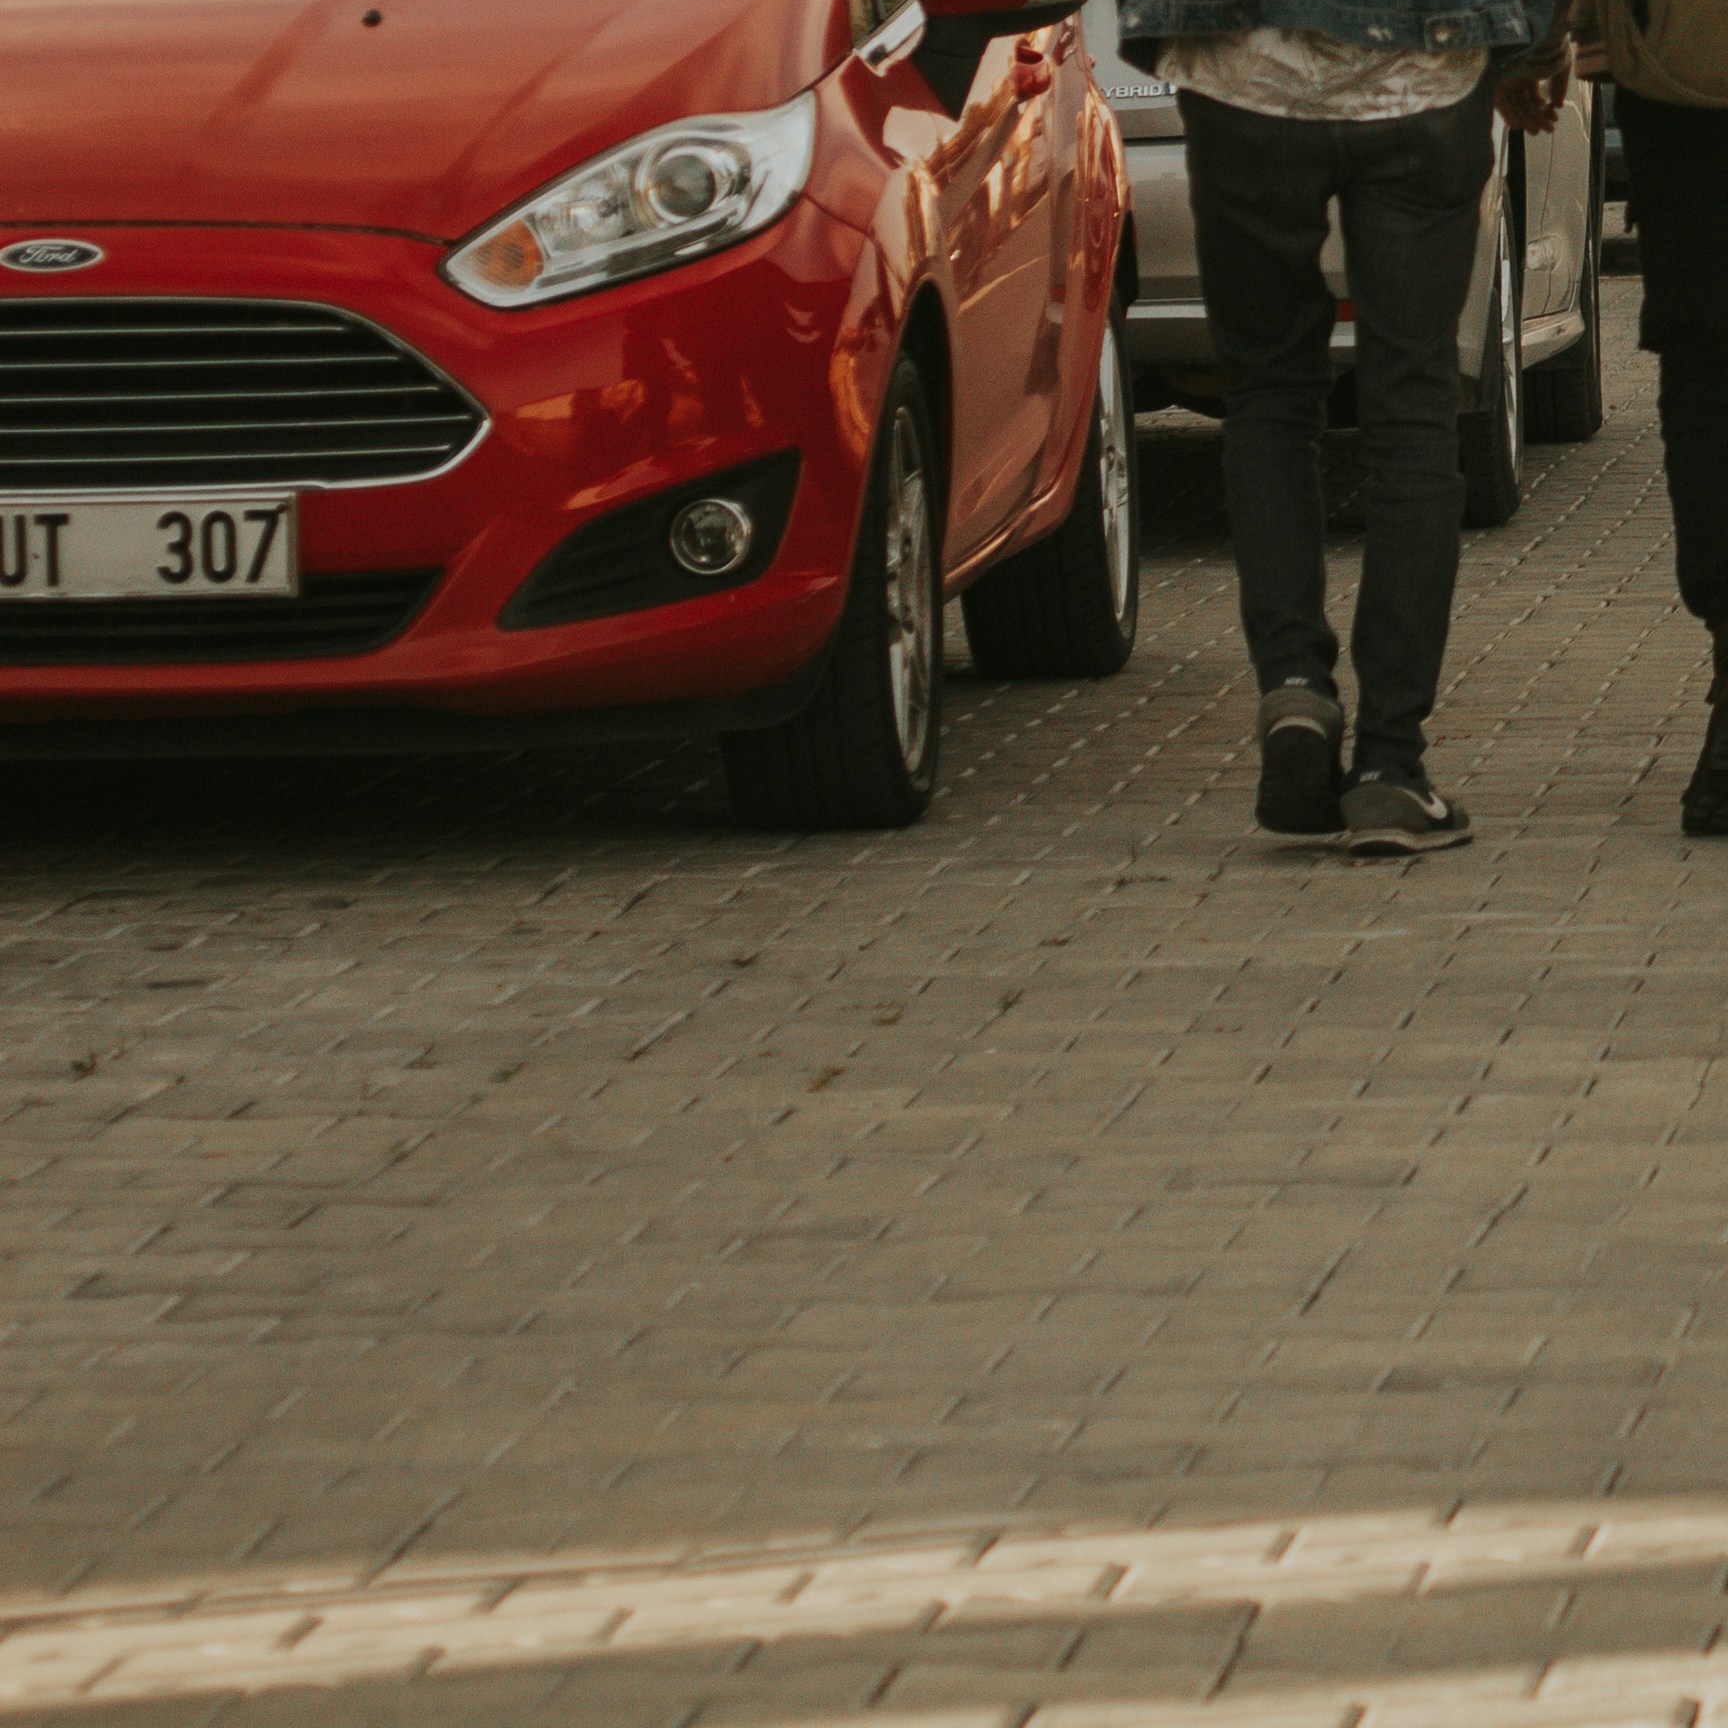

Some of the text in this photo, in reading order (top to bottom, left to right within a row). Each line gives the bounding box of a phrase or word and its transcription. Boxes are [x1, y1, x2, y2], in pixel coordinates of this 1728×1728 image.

[1101, 83, 1177, 99] YBRID
[19, 244, 78, 263] Ford
[156, 508, 283, 585] 307
